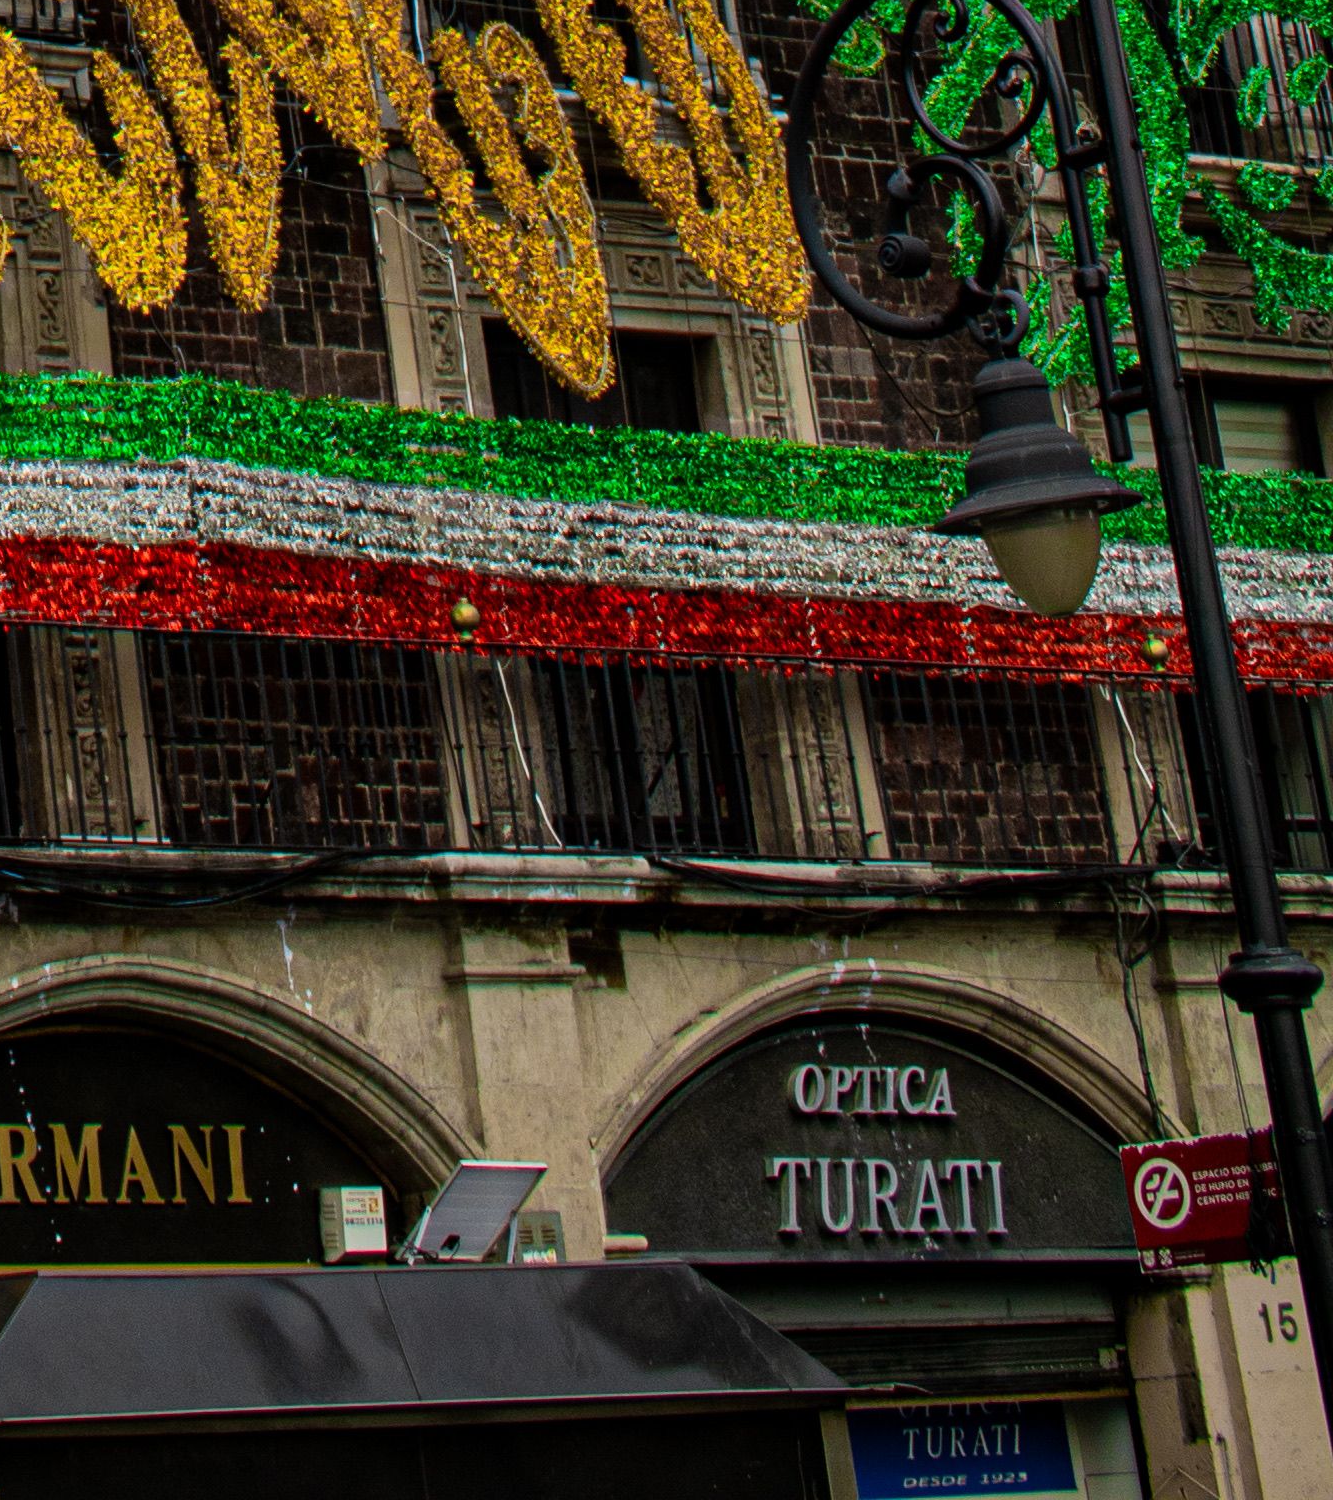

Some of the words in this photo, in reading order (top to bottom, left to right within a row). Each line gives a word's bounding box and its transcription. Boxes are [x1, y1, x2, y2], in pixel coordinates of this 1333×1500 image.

[787, 1063, 958, 1116] OPTICA
[1192, 1166, 1230, 1181] ESPACIO
[1194, 1183, 1207, 1194] DE
[1208, 1179, 1236, 1192] HUMO
[1236, 1177, 1250, 1188] EN
[764, 1155, 1009, 1234] TURATI
[1197, 1192, 1234, 1206] CENTRO
[1257, 1301, 1299, 1344] 15
[902, 1423, 1022, 1461] TURATI
[903, 1474, 968, 1489] DESDE
